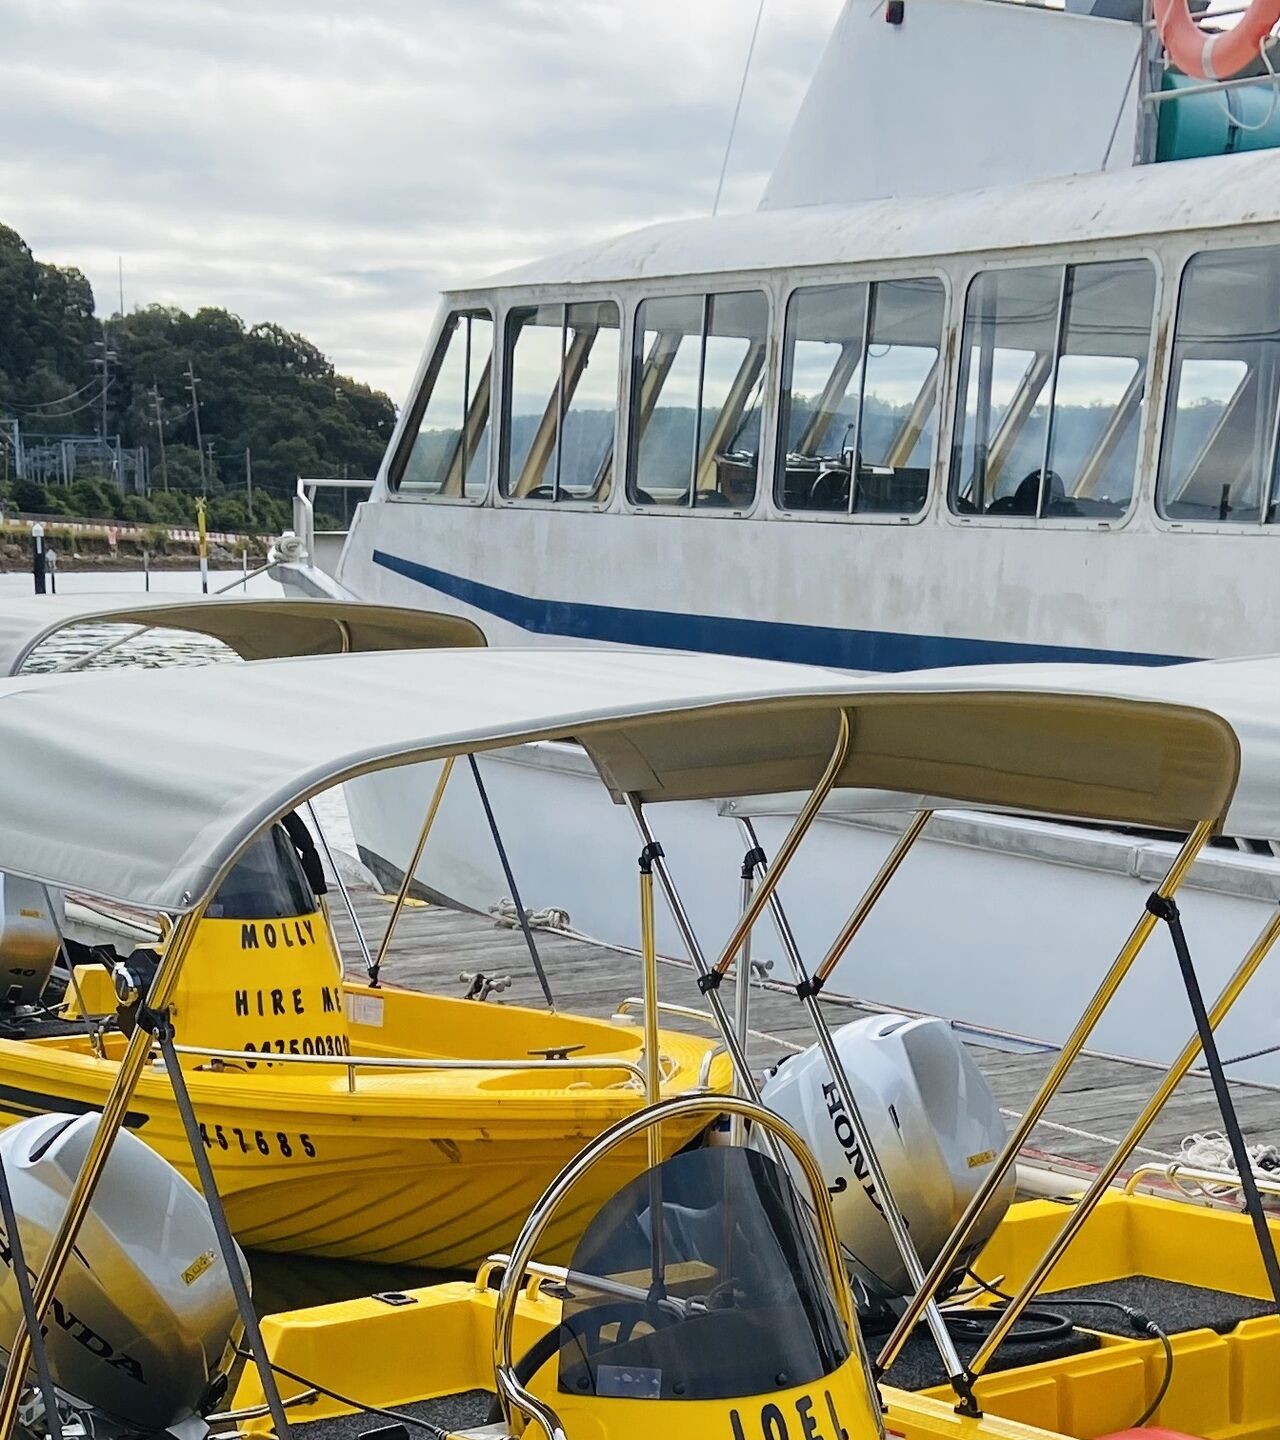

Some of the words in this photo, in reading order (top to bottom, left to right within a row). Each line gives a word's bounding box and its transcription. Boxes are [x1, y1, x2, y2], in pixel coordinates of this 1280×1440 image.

[241, 919, 316, 950] MOLLY
[9, 968, 36, 978] 40
[235, 988, 305, 1017] HIRE
[321, 986, 342, 1013] ME
[822, 1081, 910, 1230] HON
